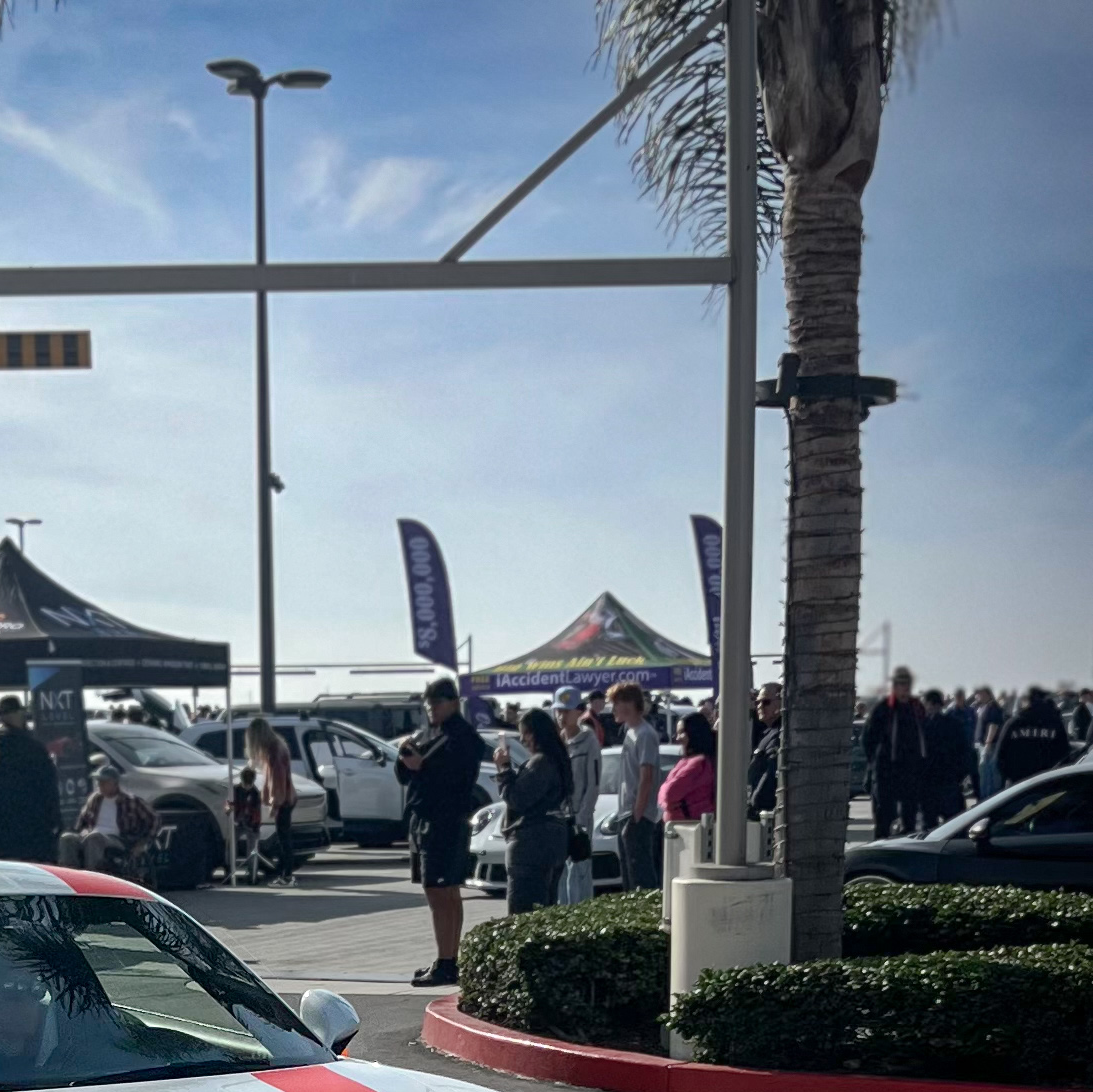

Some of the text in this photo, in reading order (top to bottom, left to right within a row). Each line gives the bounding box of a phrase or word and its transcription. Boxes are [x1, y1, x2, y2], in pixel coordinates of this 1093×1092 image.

[496, 670, 650, 688] iAccidentLawyer.com
[40, 690, 74, 710] NXT
[1011, 728, 1056, 739] AMIRI
